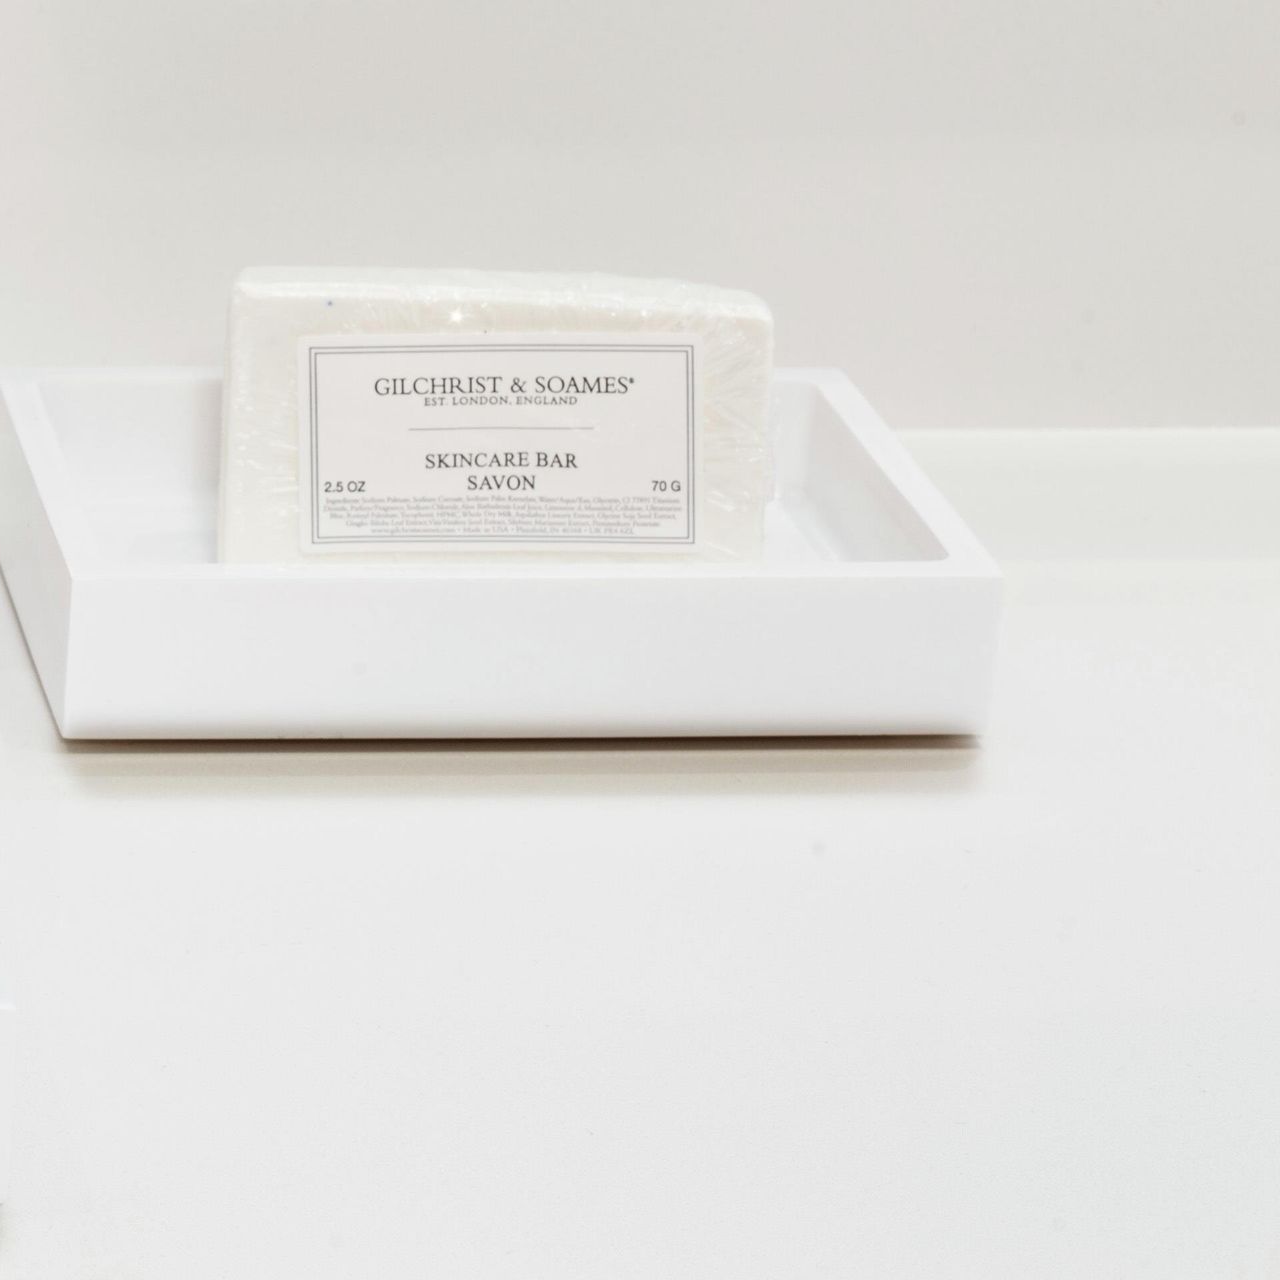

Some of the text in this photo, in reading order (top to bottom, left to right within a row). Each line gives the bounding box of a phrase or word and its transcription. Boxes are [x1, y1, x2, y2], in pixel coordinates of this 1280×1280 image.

[374, 376, 503, 396] GILCHRIST
[510, 377, 526, 394] &
[515, 395, 578, 406] ENGLAND
[425, 451, 578, 469] SKINCARE BAR
[323, 480, 366, 493] 2.5 OZ
[467, 474, 536, 491] SAVON
[651, 479, 682, 493] 70 G
